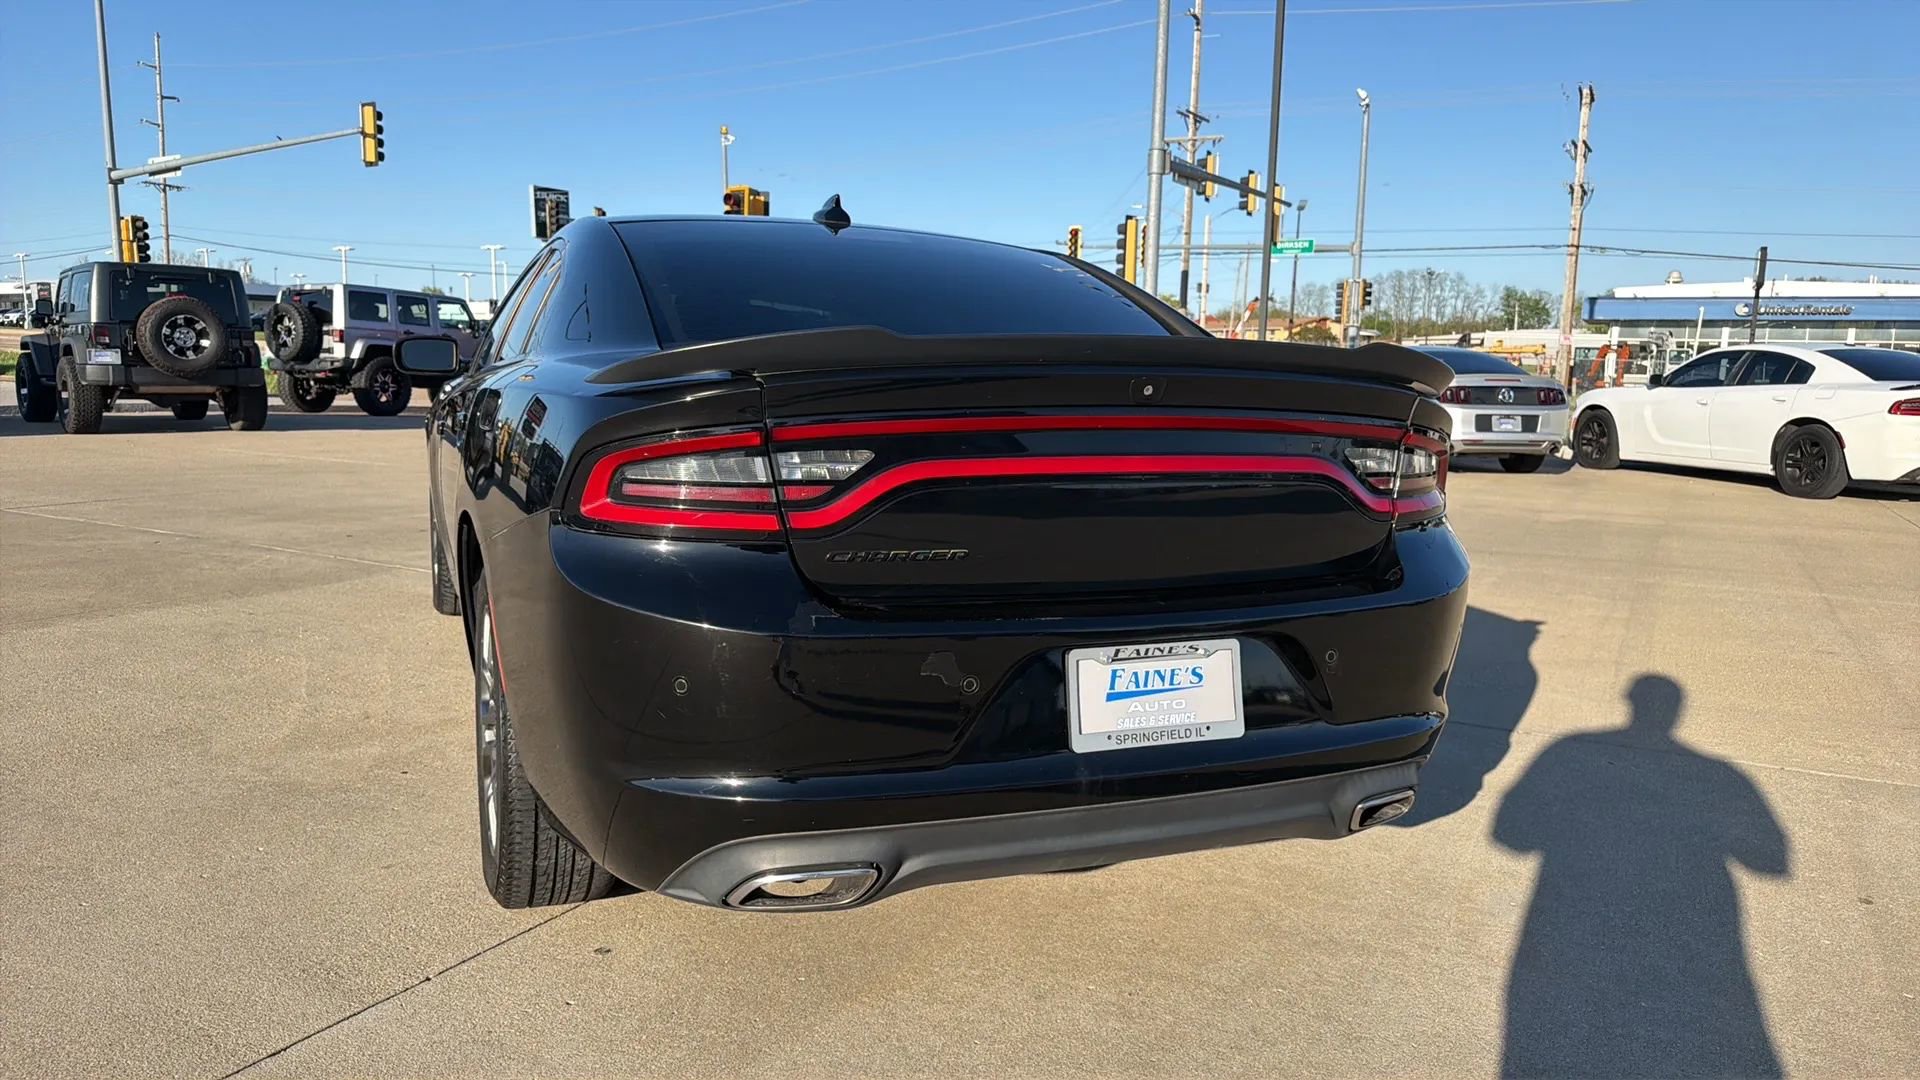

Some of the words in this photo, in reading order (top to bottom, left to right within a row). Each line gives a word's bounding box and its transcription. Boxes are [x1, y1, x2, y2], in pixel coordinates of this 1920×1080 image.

[825, 549, 970, 562] CHARGER
[1112, 644, 1200, 658] FAINE'S
[1108, 665, 1204, 691] FAINE'S
[1127, 699, 1186, 713] AUTO
[1116, 715, 1147, 729] SALES
[1156, 712, 1197, 726] SERVICE
[1115, 727, 1193, 746] SPRINGFIELD
[1195, 726, 1206, 738] IL
